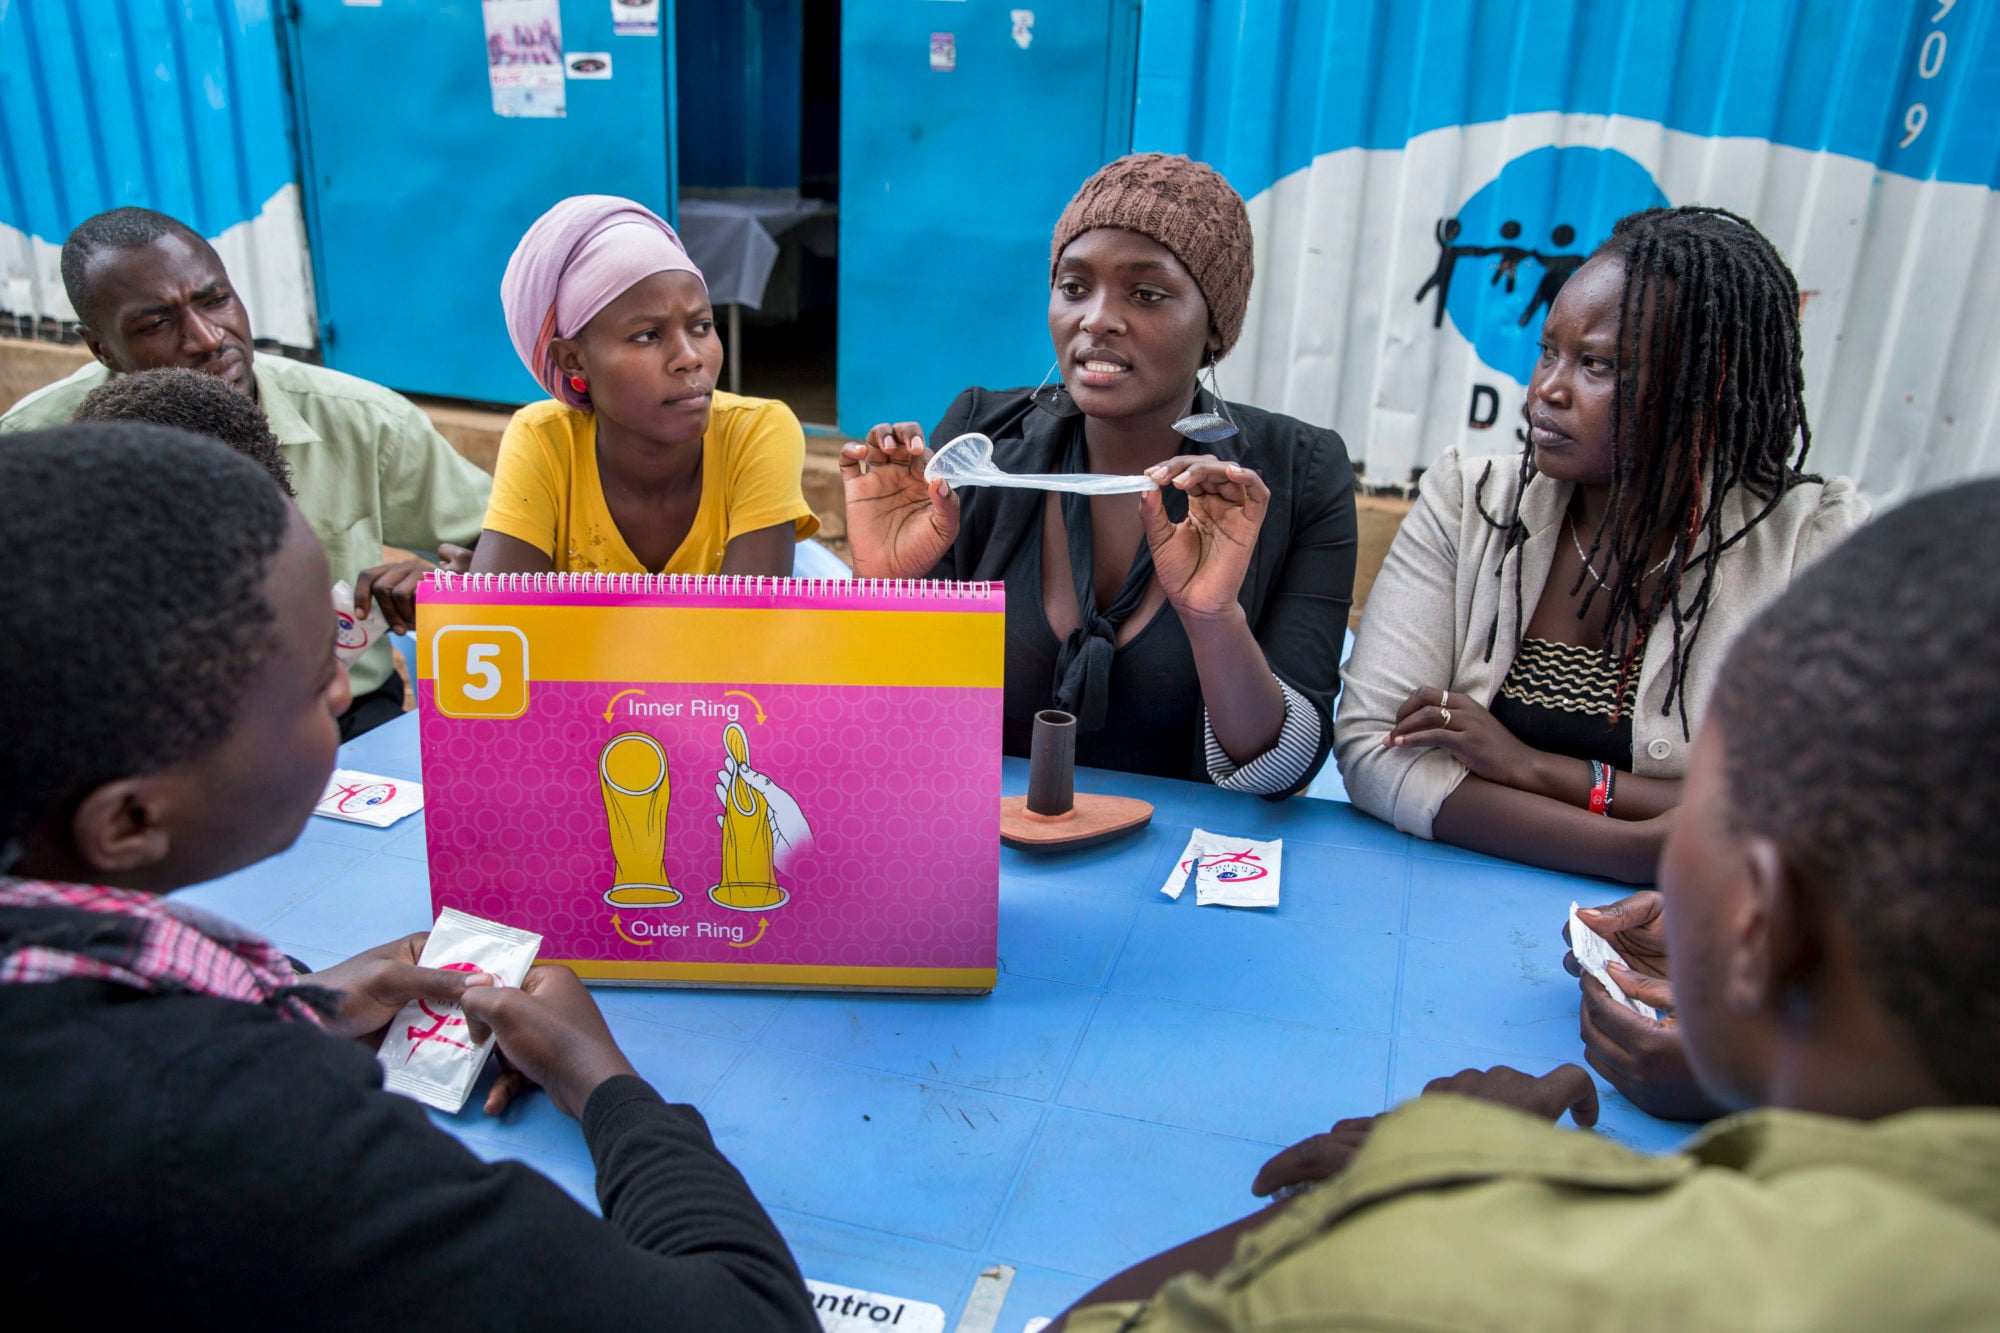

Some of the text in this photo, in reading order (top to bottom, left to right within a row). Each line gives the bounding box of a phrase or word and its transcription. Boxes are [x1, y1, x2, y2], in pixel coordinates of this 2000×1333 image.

[462, 643, 502, 701] 5
[629, 699, 739, 721] Inner Ring
[631, 920, 744, 942] Outer Ring
